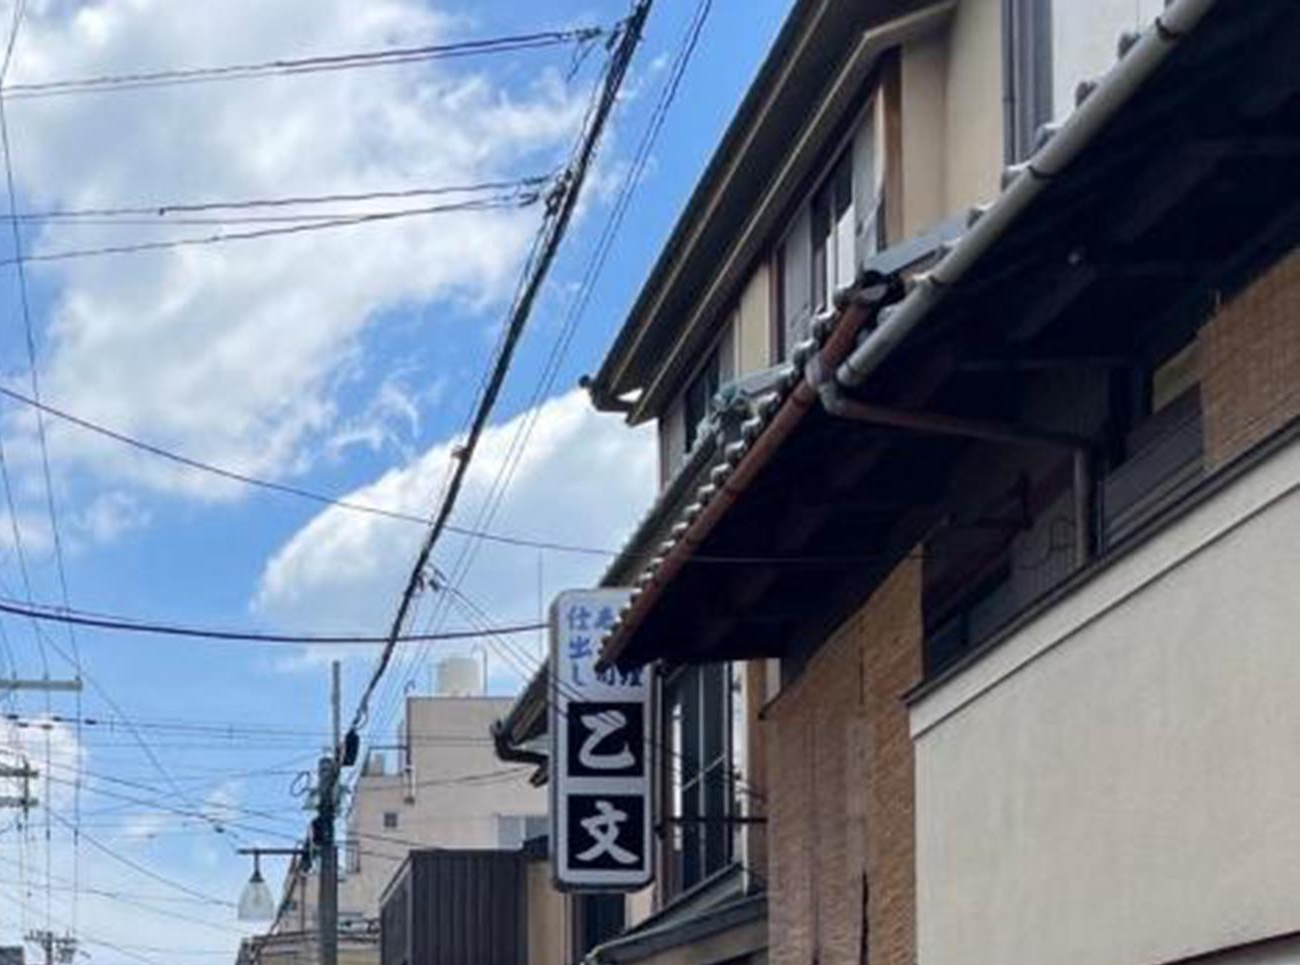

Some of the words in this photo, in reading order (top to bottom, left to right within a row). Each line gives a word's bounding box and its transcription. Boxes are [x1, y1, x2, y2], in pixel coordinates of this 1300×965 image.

[568, 605, 593, 687] 仕出し
[575, 709, 640, 865] 乙文
